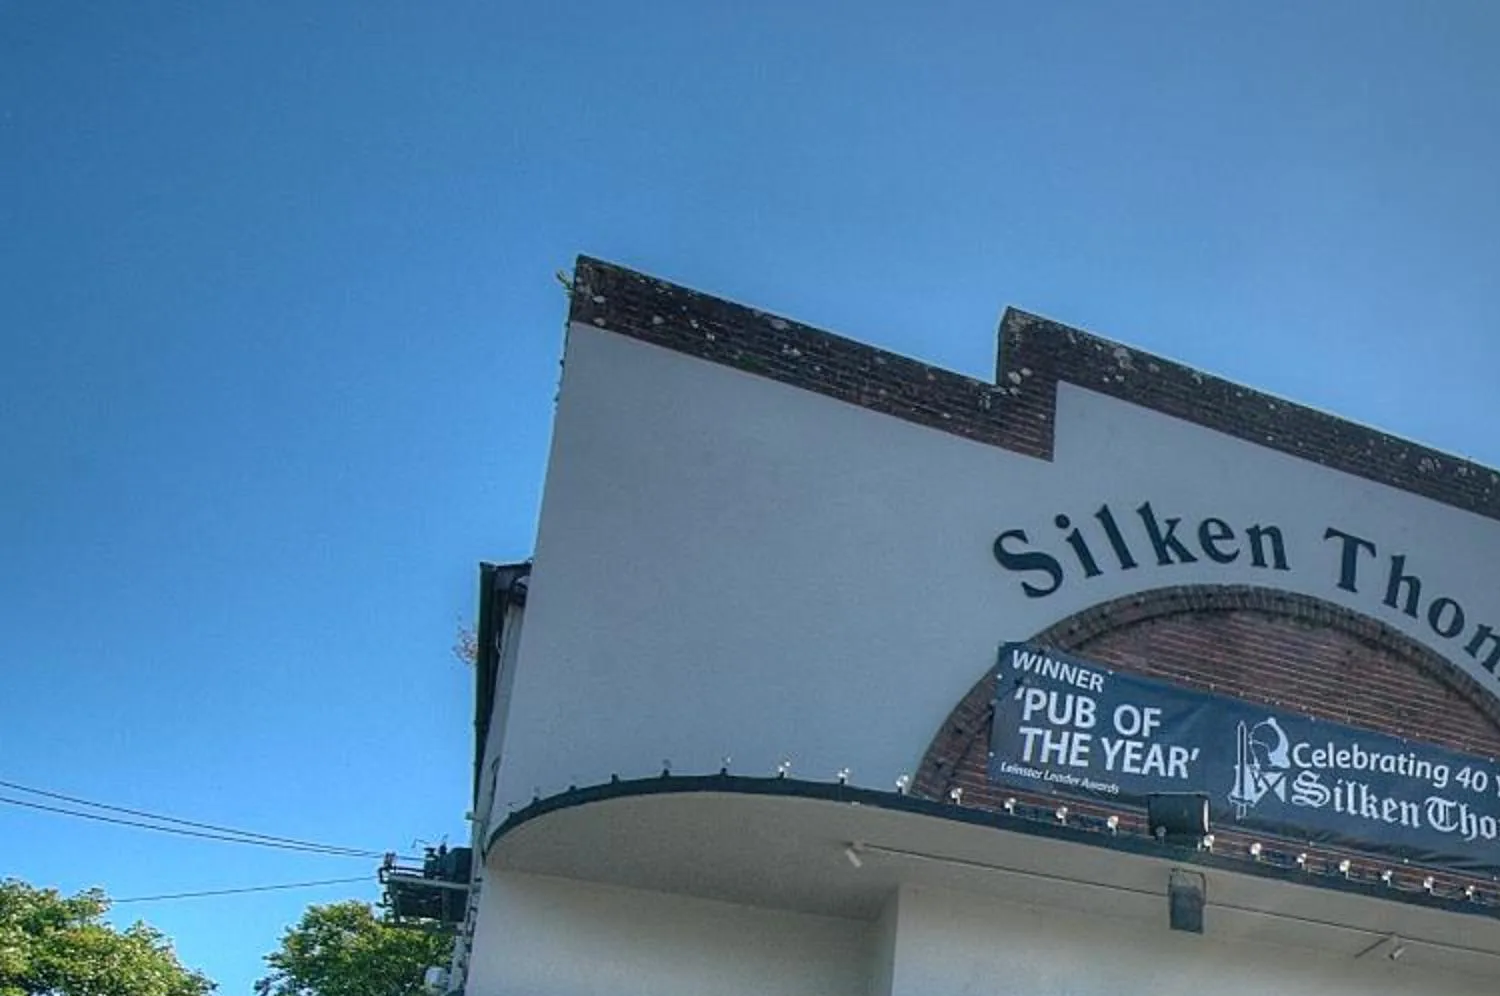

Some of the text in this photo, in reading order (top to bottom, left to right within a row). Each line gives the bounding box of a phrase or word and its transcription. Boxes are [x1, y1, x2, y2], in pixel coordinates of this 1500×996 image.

[993, 501, 1290, 598] Silken
[1012, 650, 1104, 692] WINNER
[1014, 686, 1162, 737] 'PUB OF
[1000, 761, 1120, 794] Leinster Leader Awards
[1019, 727, 1200, 779] THE YEAR'
[1292, 742, 1449, 788] Celebrating
[1455, 766, 1487, 792] 40
[1291, 770, 1419, 828] Silken
